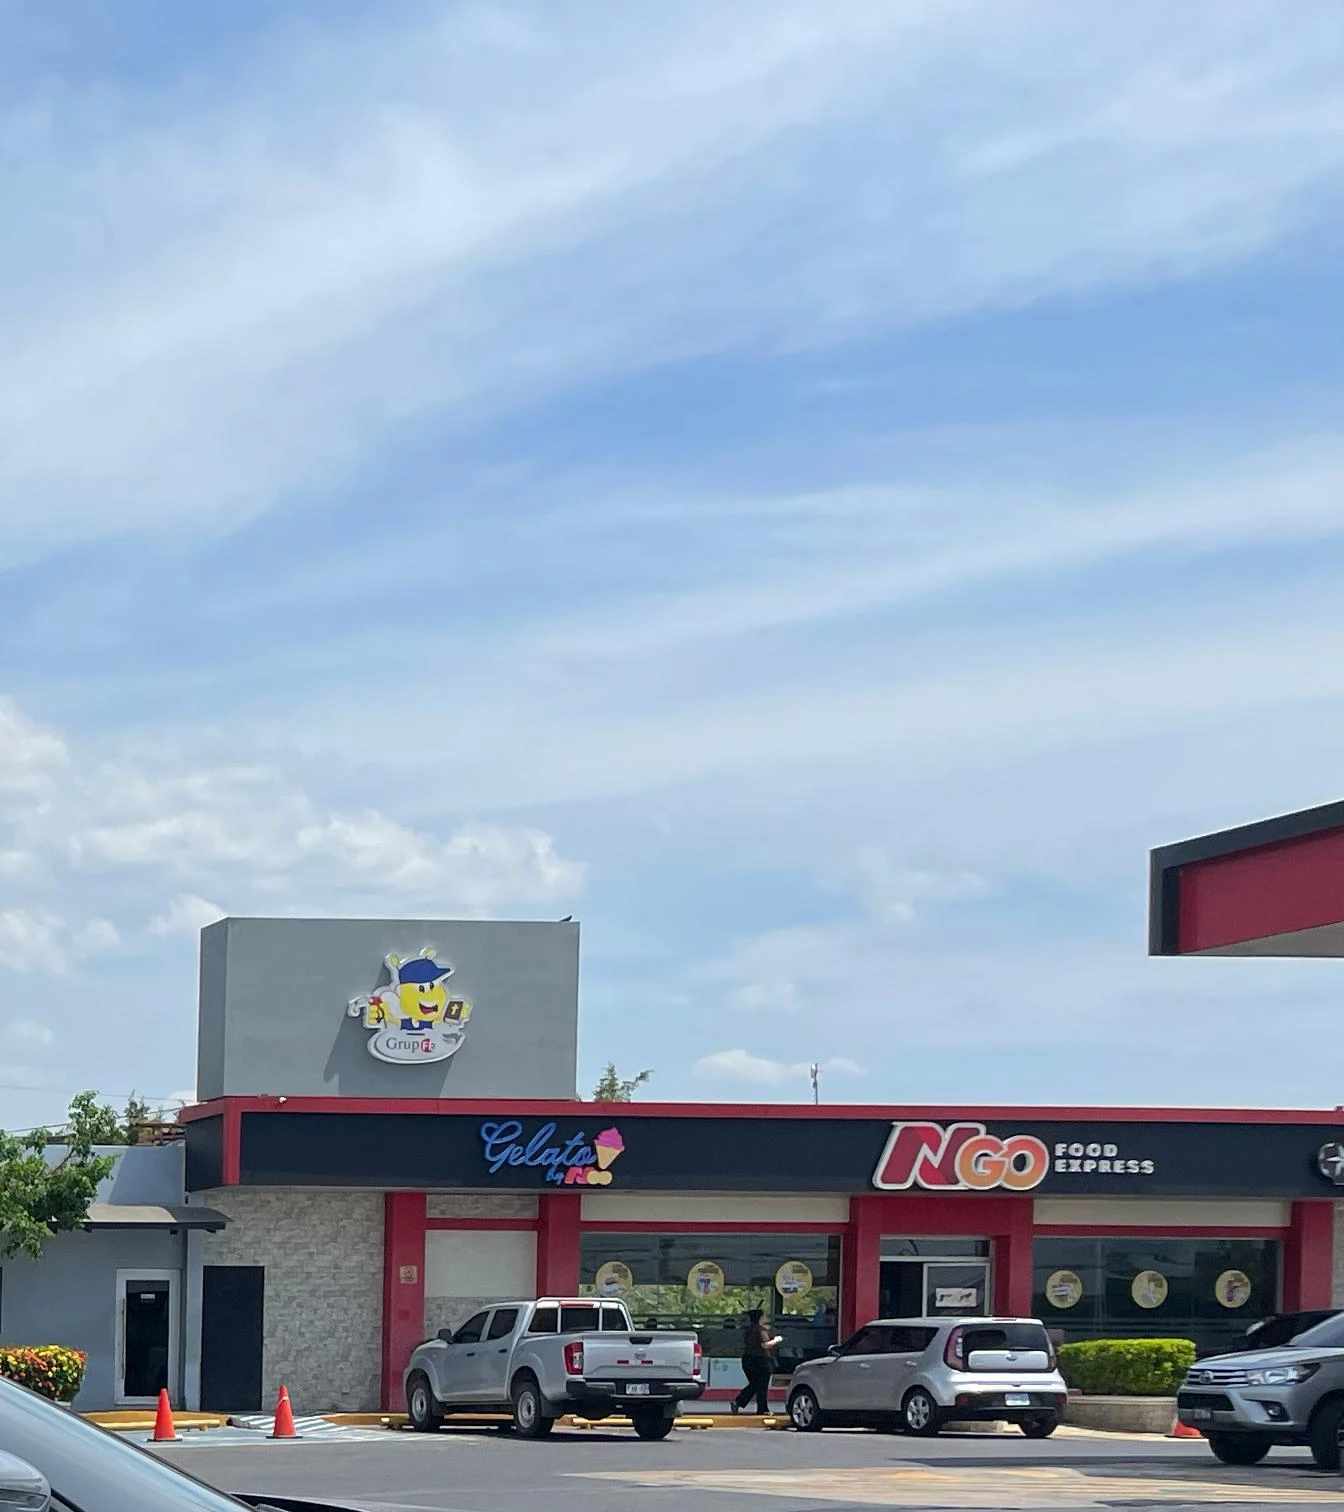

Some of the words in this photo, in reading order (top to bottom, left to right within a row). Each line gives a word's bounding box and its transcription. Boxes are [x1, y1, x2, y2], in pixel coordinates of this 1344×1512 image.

[480, 1120, 597, 1174] Gelato
[872, 1121, 1050, 1190] NGO
[1054, 1142, 1119, 1158] FOOD
[1054, 1159, 1155, 1174] EXPRESS
